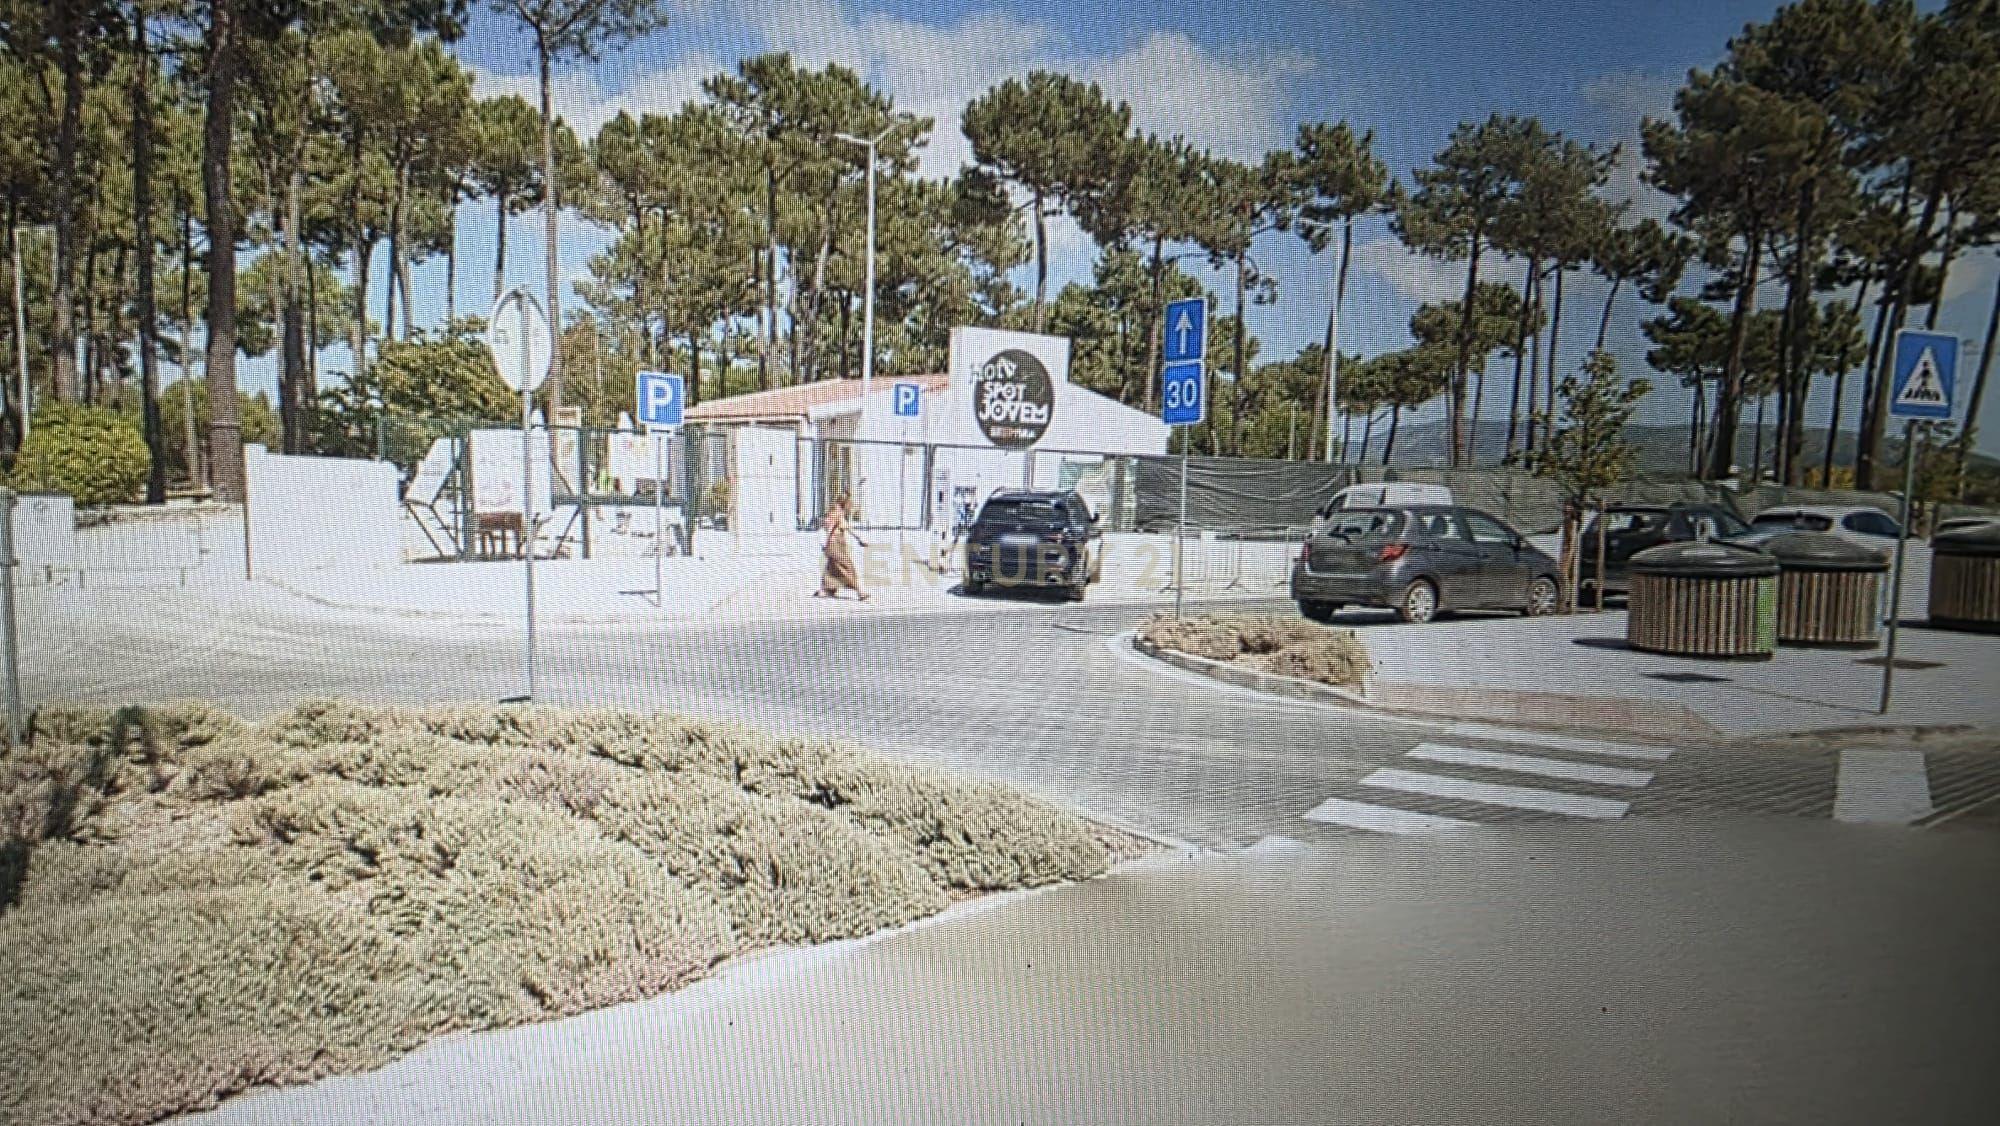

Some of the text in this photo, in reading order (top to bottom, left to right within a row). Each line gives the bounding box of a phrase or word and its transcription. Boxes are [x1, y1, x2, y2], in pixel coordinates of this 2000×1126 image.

[647, 379, 674, 420] P
[899, 386, 915, 413] P
[982, 381, 1026, 402] SPOT
[1166, 378, 1197, 408] 30
[978, 400, 1048, 424] JOVEM
